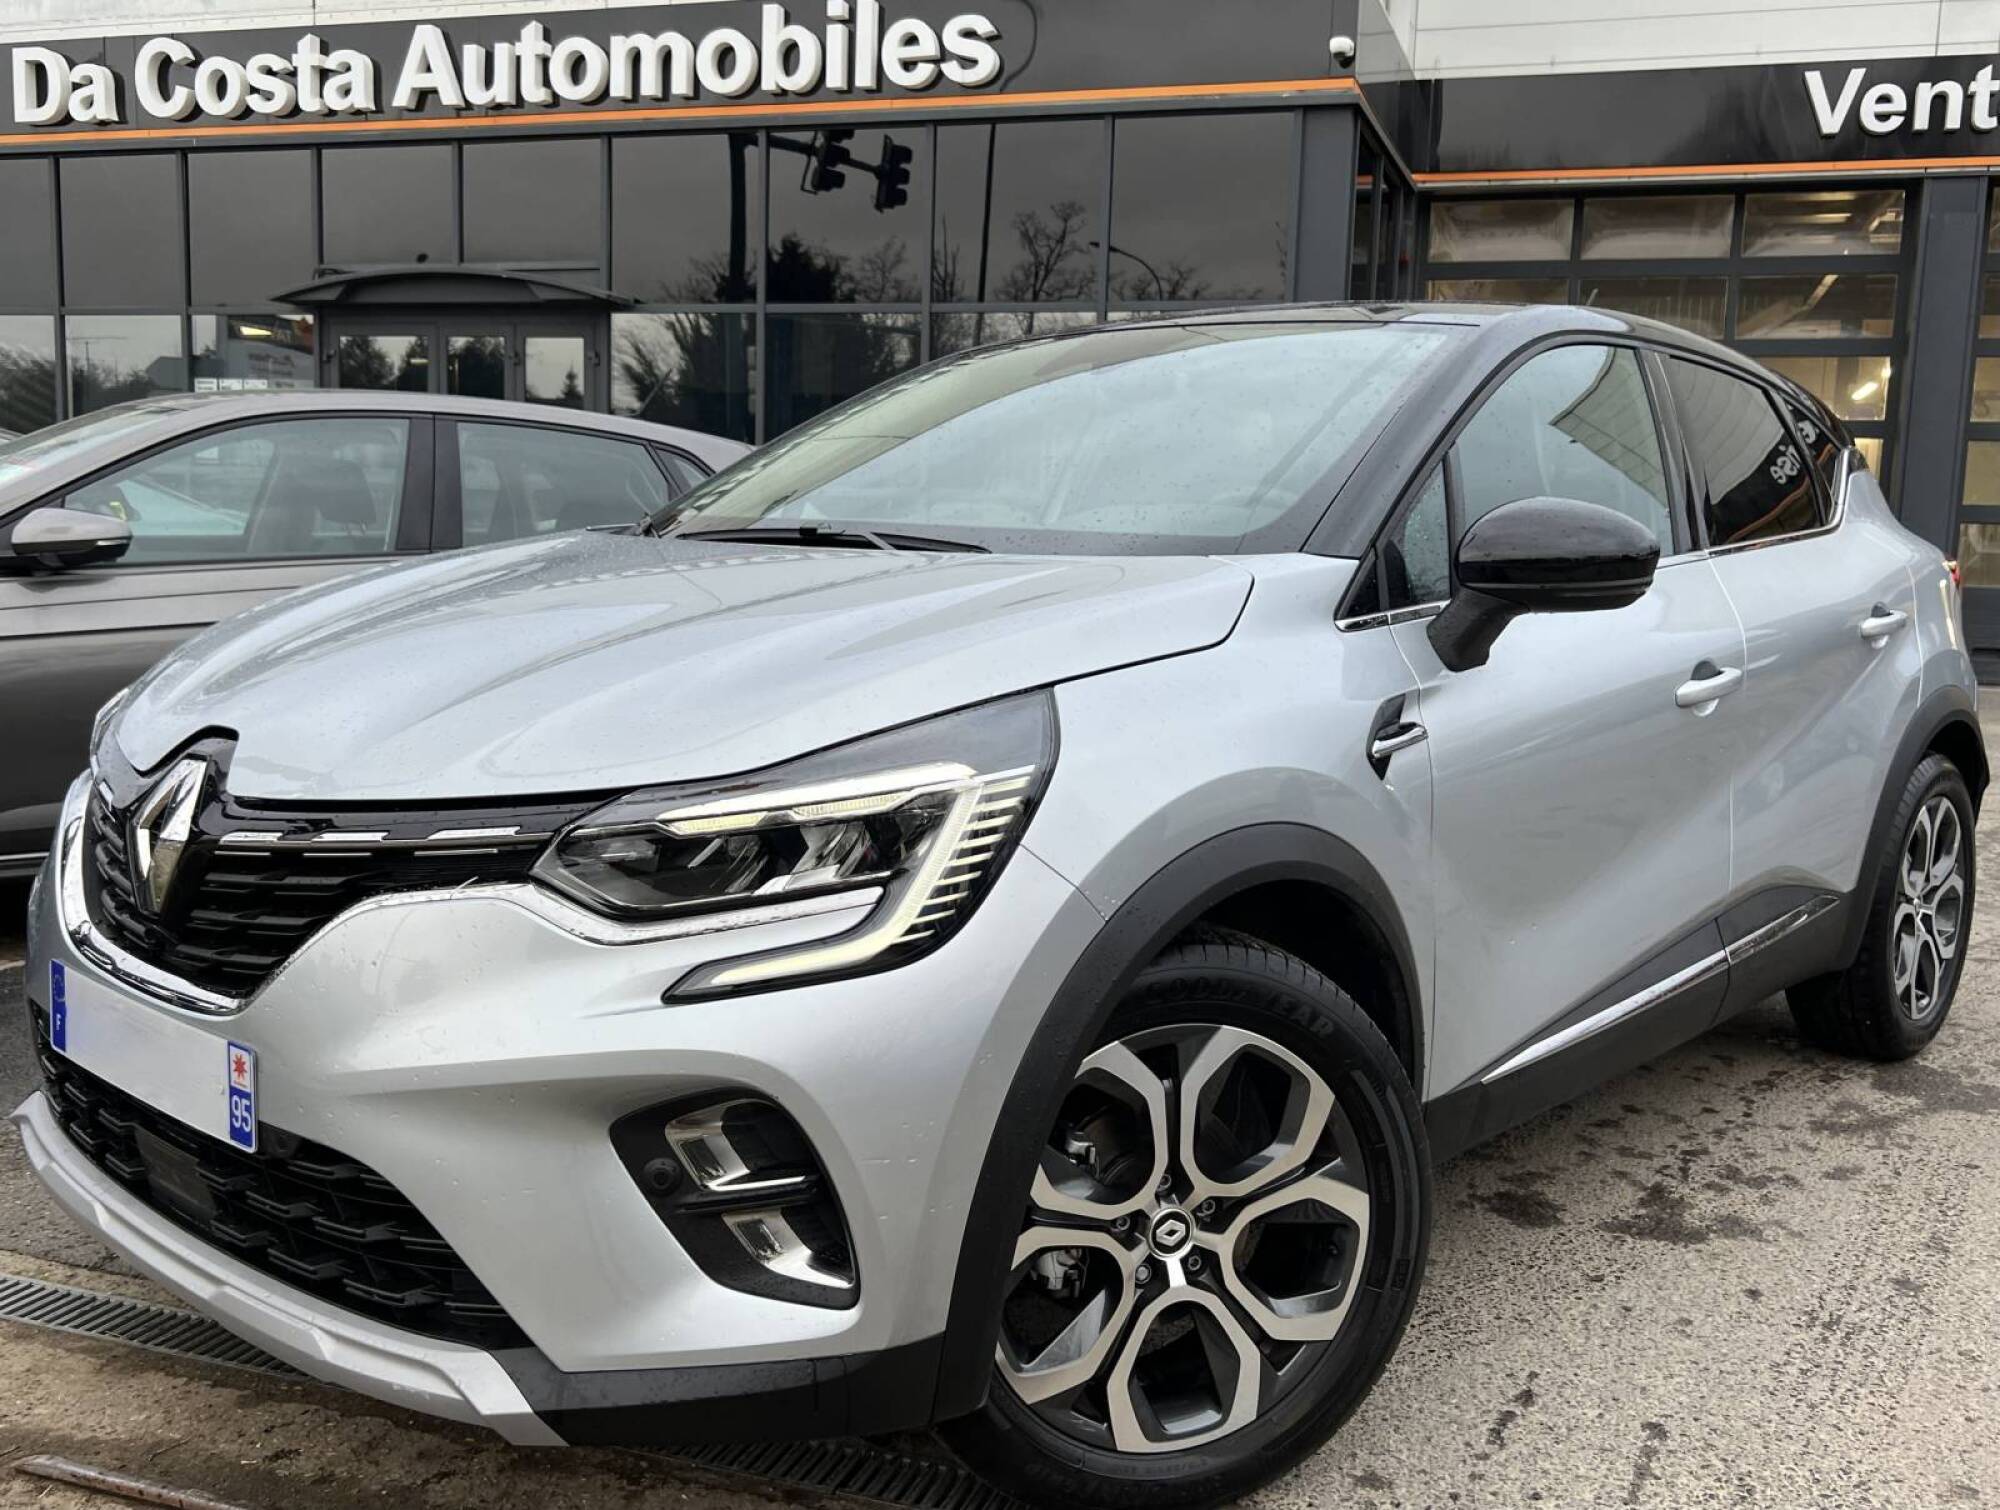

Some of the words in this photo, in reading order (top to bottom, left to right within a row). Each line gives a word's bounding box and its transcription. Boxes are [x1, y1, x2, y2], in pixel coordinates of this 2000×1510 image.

[12, 46, 120, 126] Da
[134, 32, 376, 118] Costa
[392, 0, 1002, 107] Automobiles
[231, 1094, 251, 1132] 95
